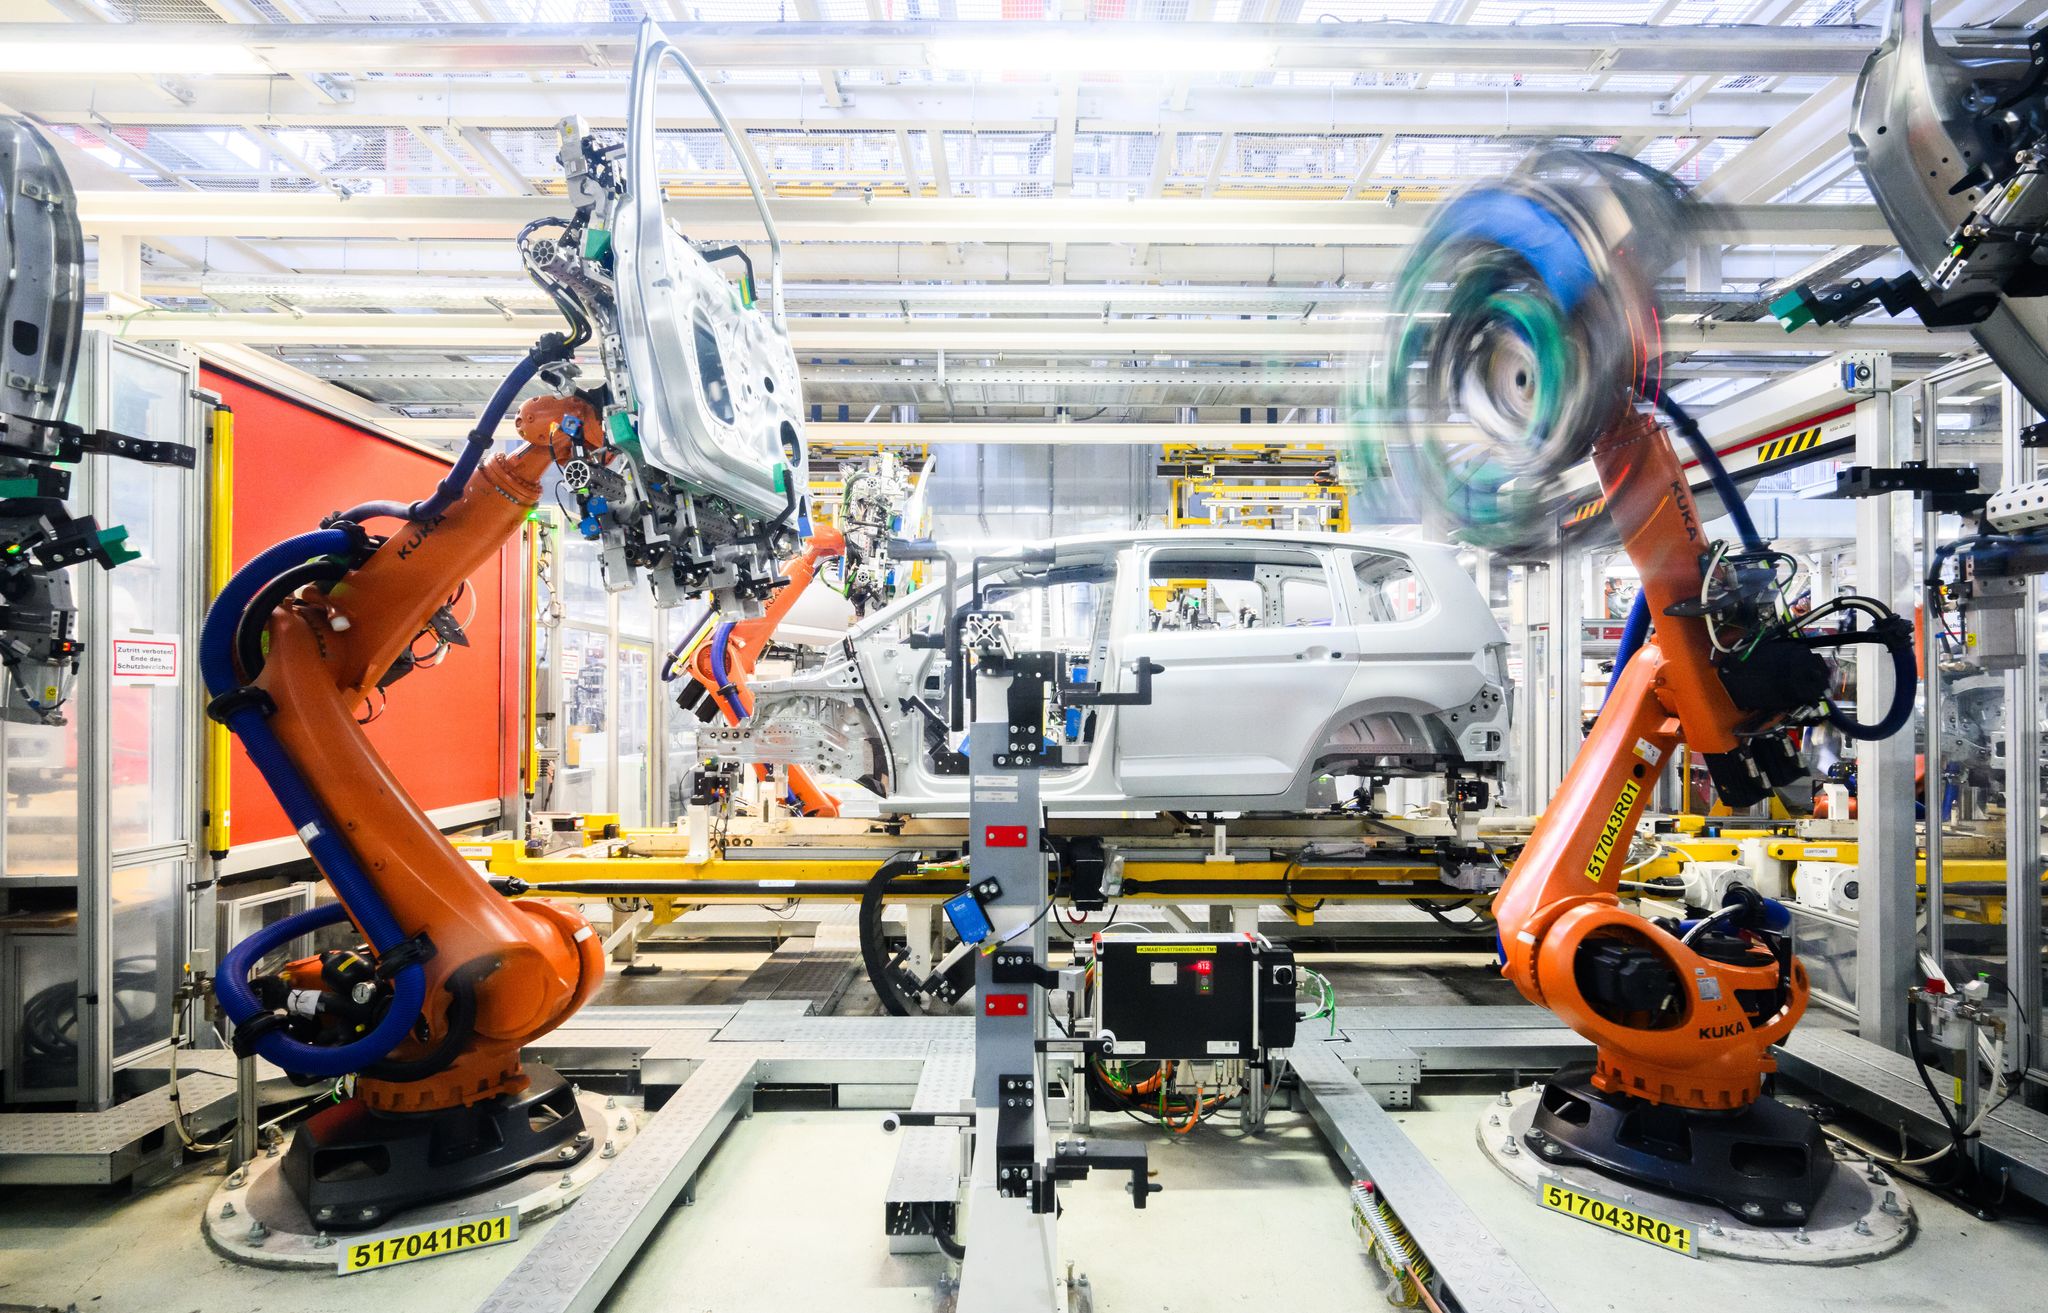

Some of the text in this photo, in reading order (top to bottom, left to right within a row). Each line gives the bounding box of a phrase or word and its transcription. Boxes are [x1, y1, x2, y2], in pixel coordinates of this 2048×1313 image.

[1670, 480, 1697, 541] KUKA
[1588, 783, 1638, 877] 517043R01
[1698, 1021, 1745, 1039] KUKA
[354, 1217, 505, 1267] 517041R01
[1549, 1187, 1685, 1249] 517043R01
